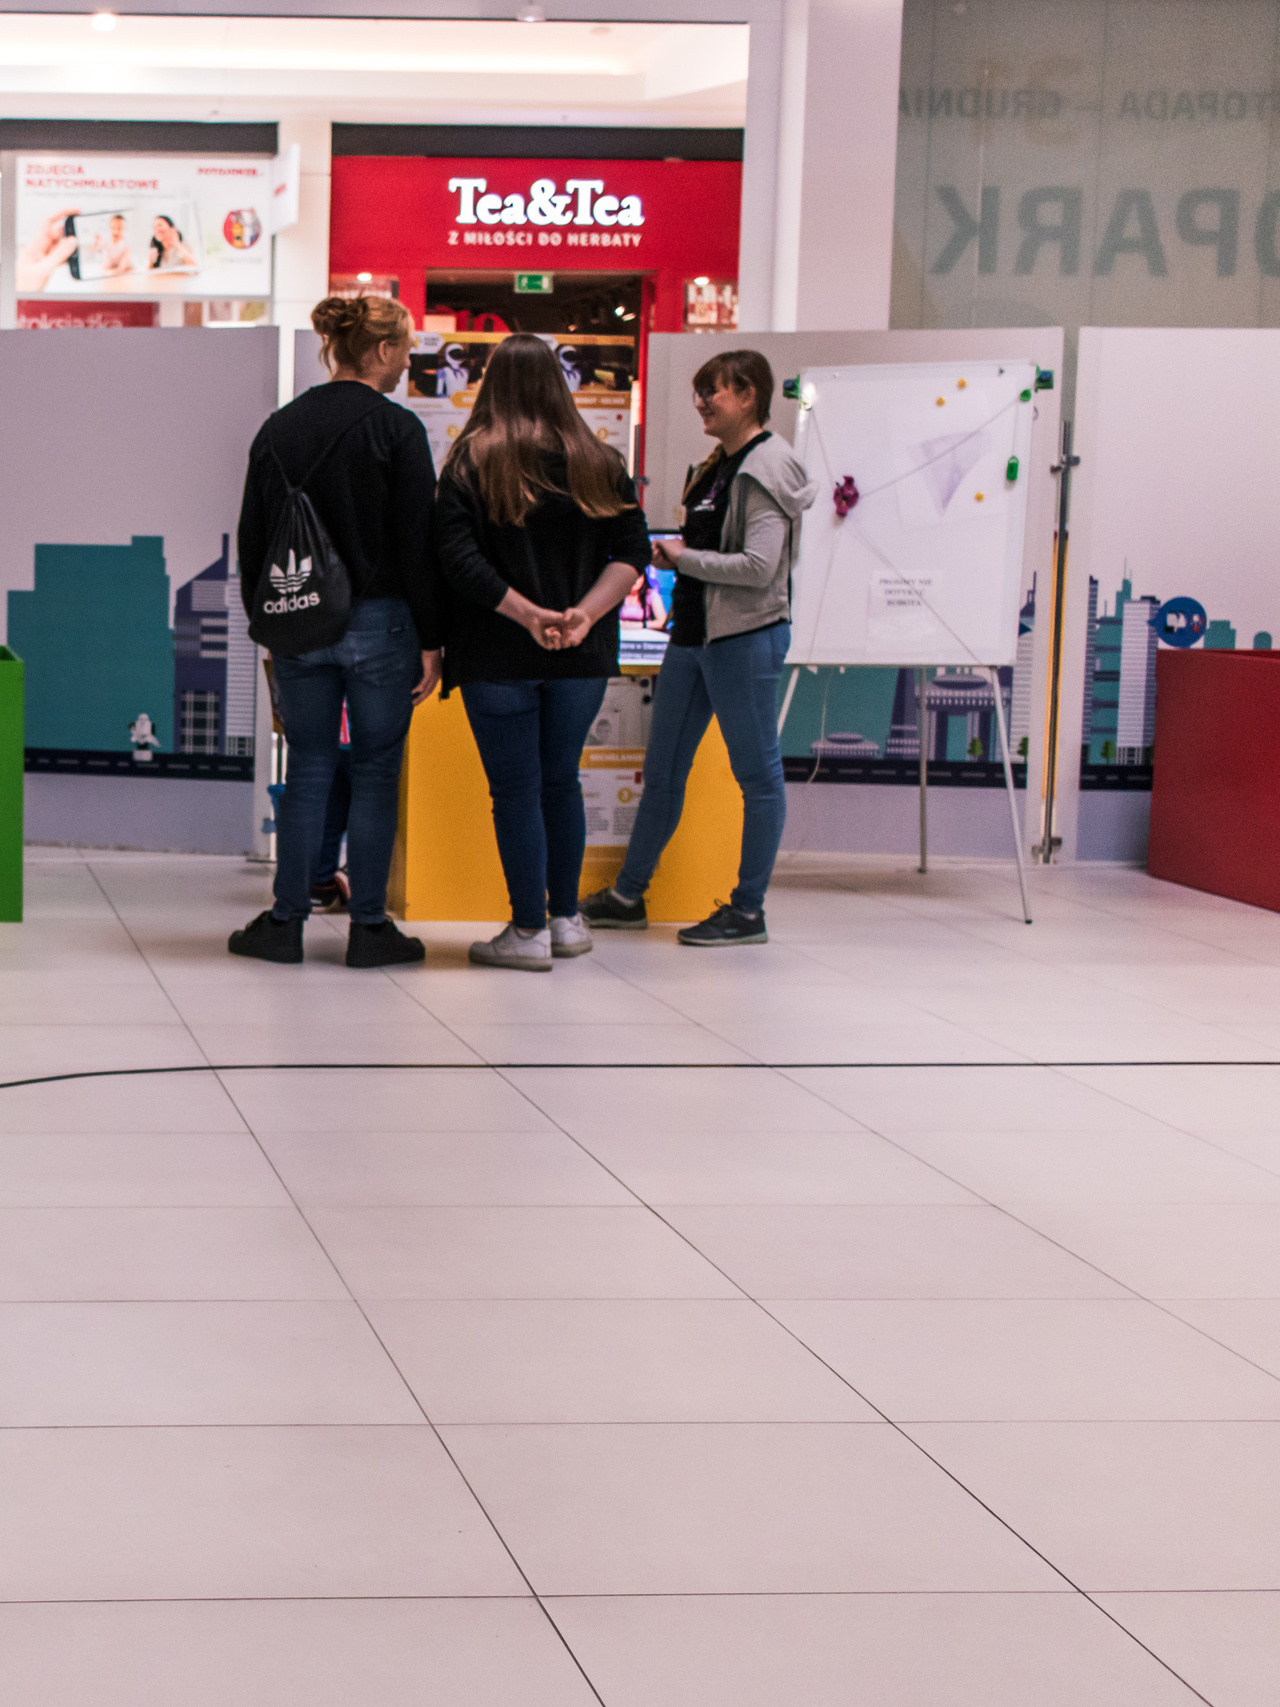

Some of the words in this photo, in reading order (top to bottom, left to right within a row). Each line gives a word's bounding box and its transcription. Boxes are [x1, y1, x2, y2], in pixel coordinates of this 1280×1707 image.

[25, 178, 159, 190] NATYCHMIASTOWE
[448, 177, 646, 226] Tea&Tea
[447, 231, 459, 245] Z
[464, 230, 533, 246] MIŁOŚCI
[538, 232, 562, 246] DO
[567, 232, 643, 247] HERBATY
[263, 591, 320, 613] adidas
